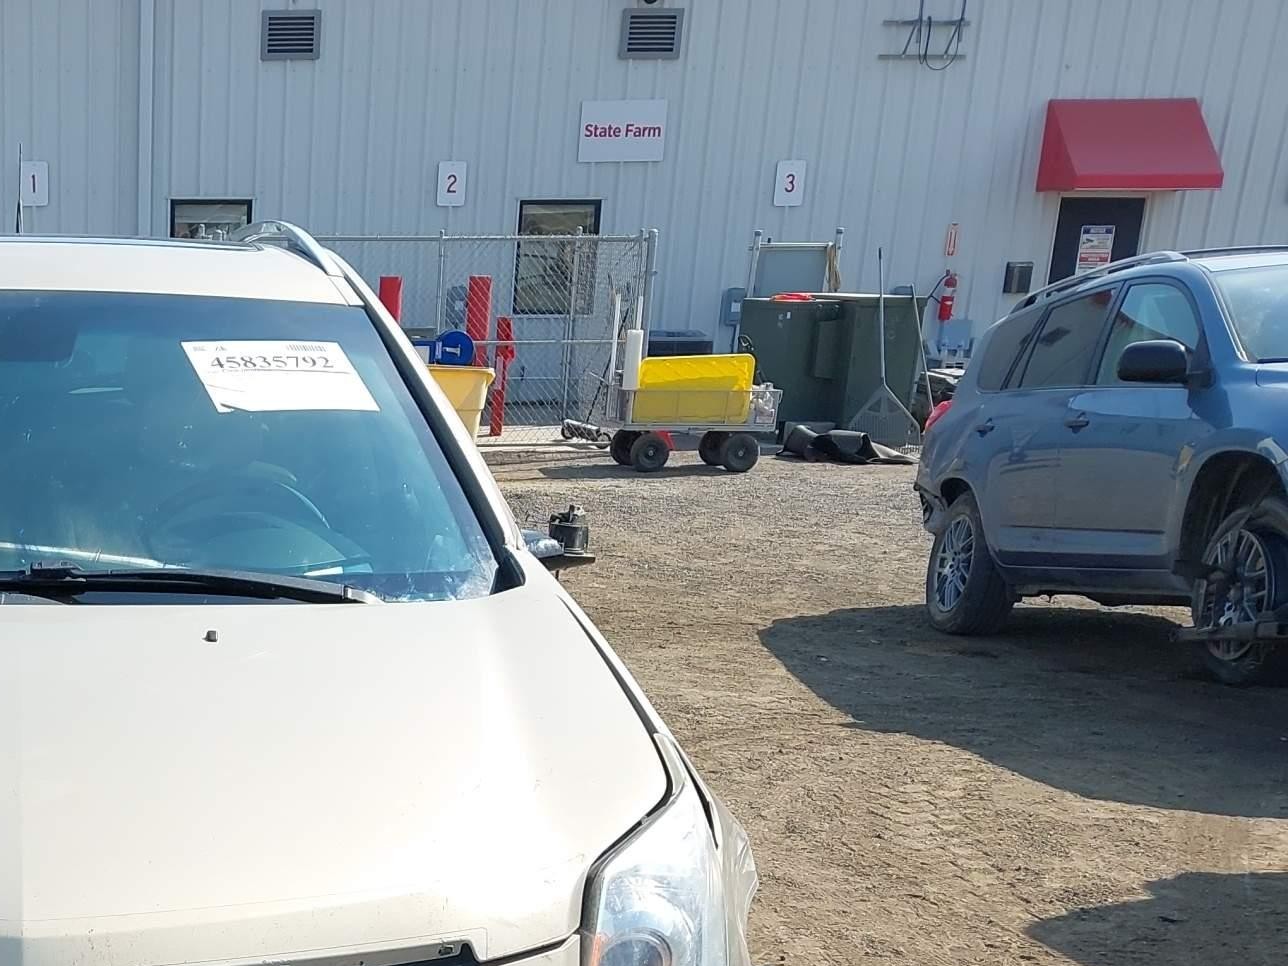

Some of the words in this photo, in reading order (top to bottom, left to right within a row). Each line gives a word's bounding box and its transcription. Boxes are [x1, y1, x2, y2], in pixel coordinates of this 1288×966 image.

[584, 123, 622, 138] State
[624, 123, 662, 138] Farm
[31, 174, 36, 193] 1
[446, 174, 457, 194] 2
[784, 173, 796, 193] 3
[210, 355, 335, 369] 45835792
